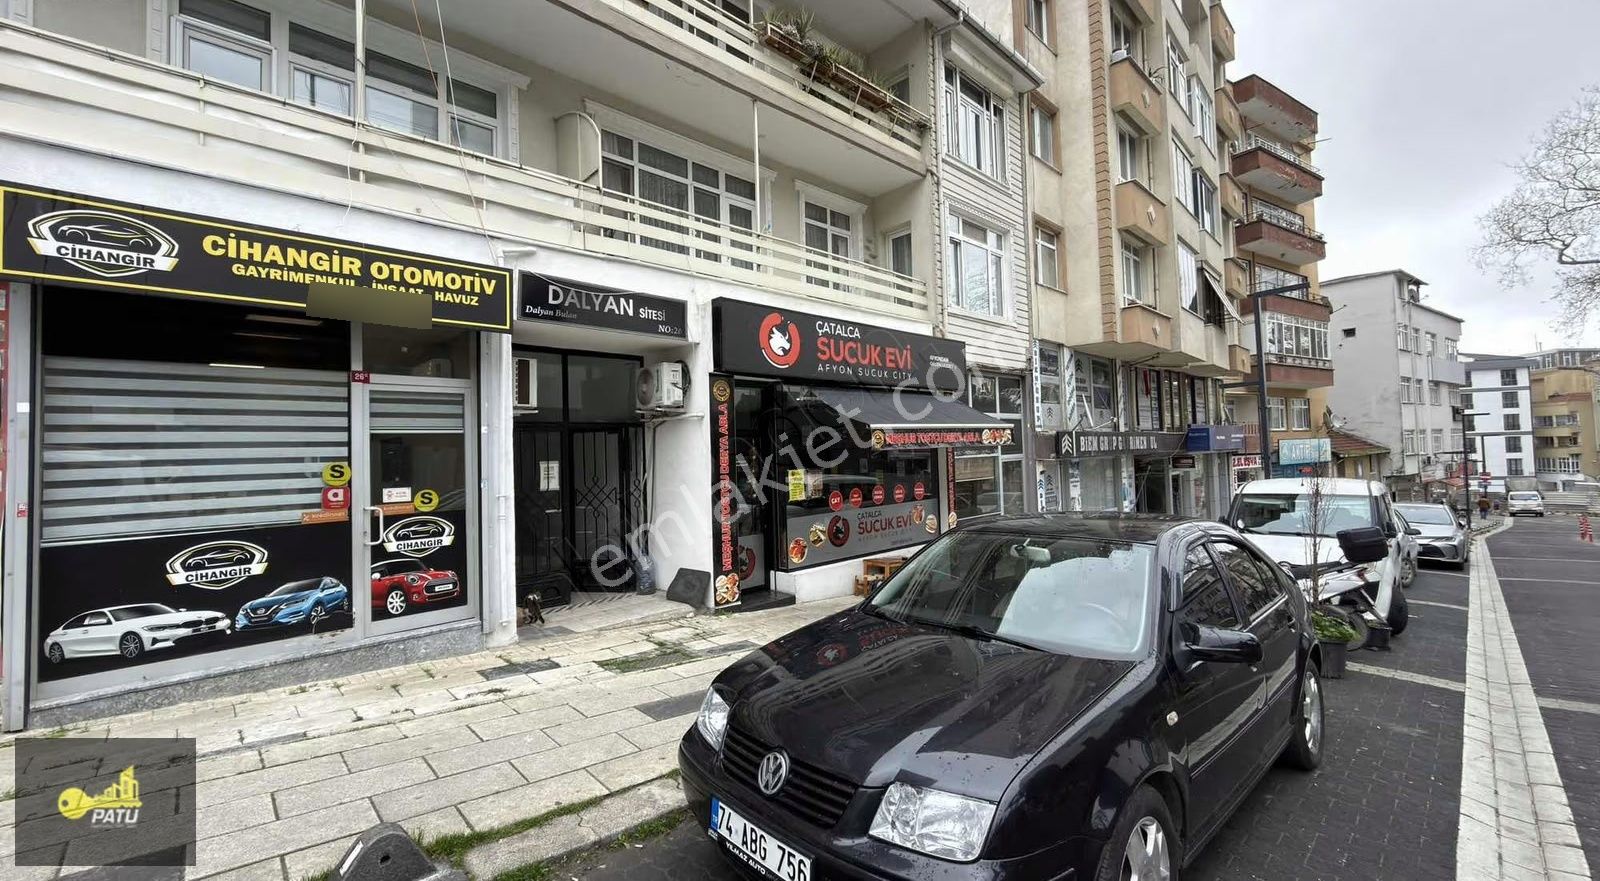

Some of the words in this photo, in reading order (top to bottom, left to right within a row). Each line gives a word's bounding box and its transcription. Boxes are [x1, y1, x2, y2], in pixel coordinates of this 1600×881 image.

[56, 244, 156, 269] CİHANGİR
[202, 233, 362, 276] CİHANGİR
[370, 260, 497, 296] OTOMOTİV
[434, 291, 480, 306] HAVUZ
[548, 284, 634, 317] DALYAN
[639, 306, 666, 322] SİTESİ
[525, 305, 554, 319] Dalyan
[815, 320, 861, 338] ÇATALCA
[817, 336, 882, 367] SUCUK
[885, 344, 912, 370] EVİ
[817, 363, 853, 375] AFYON
[858, 367, 889, 379] SUCUK
[892, 371, 912, 380] CITY
[329, 464, 345, 479] S
[420, 491, 433, 505] S
[858, 516, 895, 535] SUCUK
[896, 510, 912, 528] EVİ
[396, 537, 444, 551] CİHANGİR
[184, 564, 253, 583] CİHANGİR
[719, 805, 733, 837] 74
[741, 822, 768, 861] ABG
[776, 844, 808, 881] 756
[748, 858, 766, 875] AUTO
